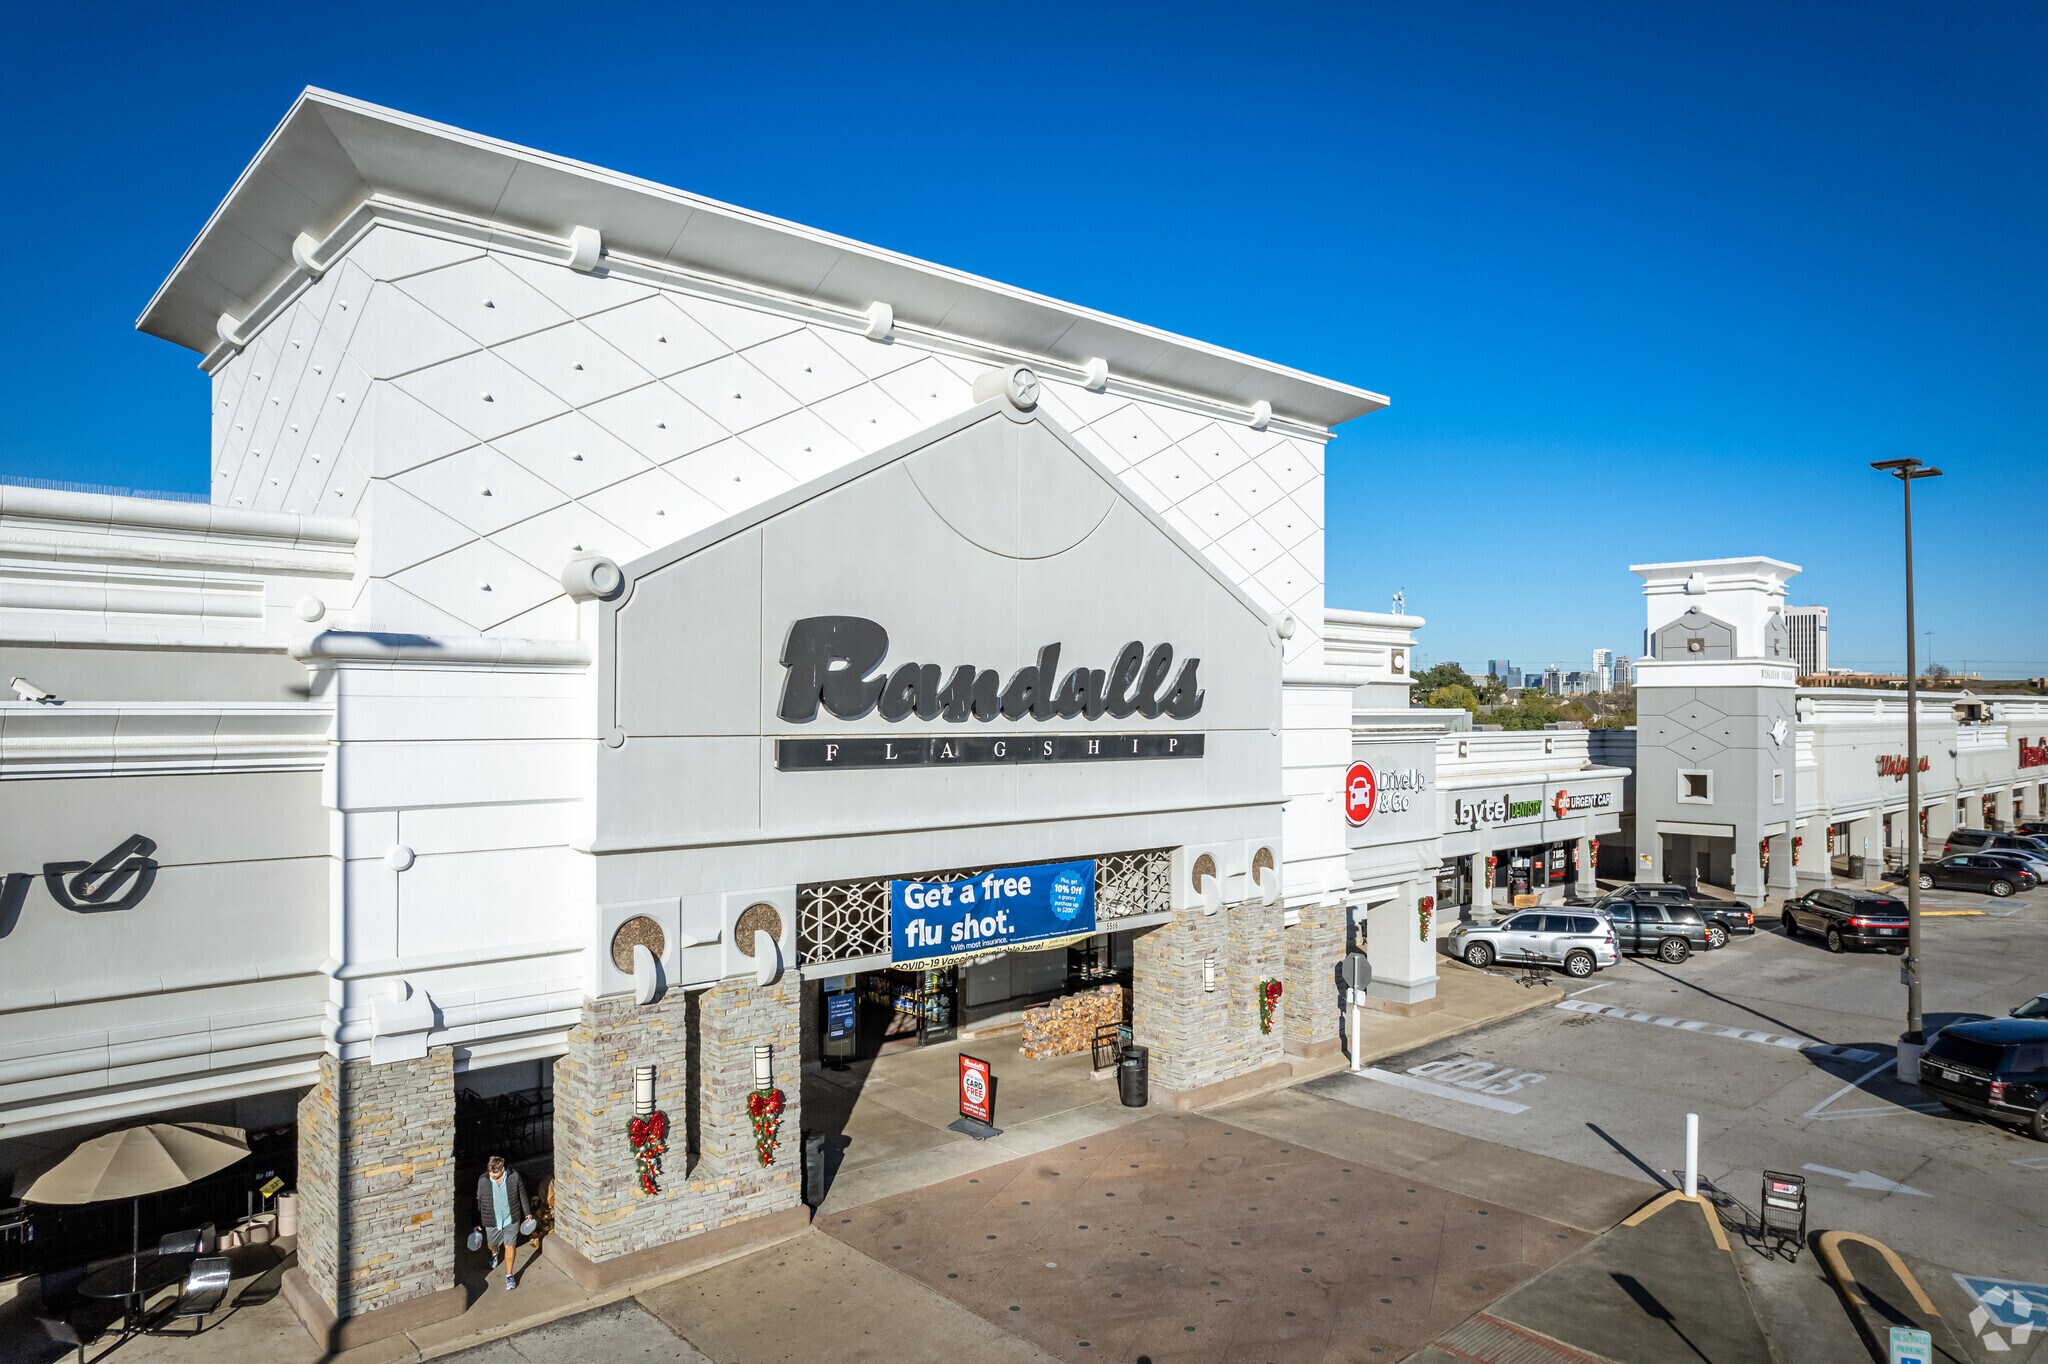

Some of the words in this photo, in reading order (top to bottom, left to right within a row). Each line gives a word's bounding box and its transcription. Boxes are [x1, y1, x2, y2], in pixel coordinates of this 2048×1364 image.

[776, 615, 1205, 723] Randalls
[826, 738, 1179, 763] FLAGSHIP
[1377, 769, 1426, 794] DriveUp
[1378, 793, 1388, 813] &
[1391, 792, 1410, 812] Go
[1558, 794, 1570, 809] afc
[1570, 794, 1597, 809] URGENT
[1458, 799, 1506, 828] byte
[1511, 800, 1543, 819] DENTISTRY
[904, 883, 953, 910] Get
[959, 884, 976, 904] a
[981, 873, 1032, 900] free
[1054, 884, 1070, 894] 10%
[1070, 885, 1083, 895] Off
[904, 918, 943, 948] flu
[950, 943, 965, 952] With
[965, 941, 981, 950] most
[981, 937, 1008, 947] insurance.
[966, 1078, 983, 1090] CARD
[966, 1085, 984, 1099] FREE
[1897, 1344, 1926, 1357] PARKING
